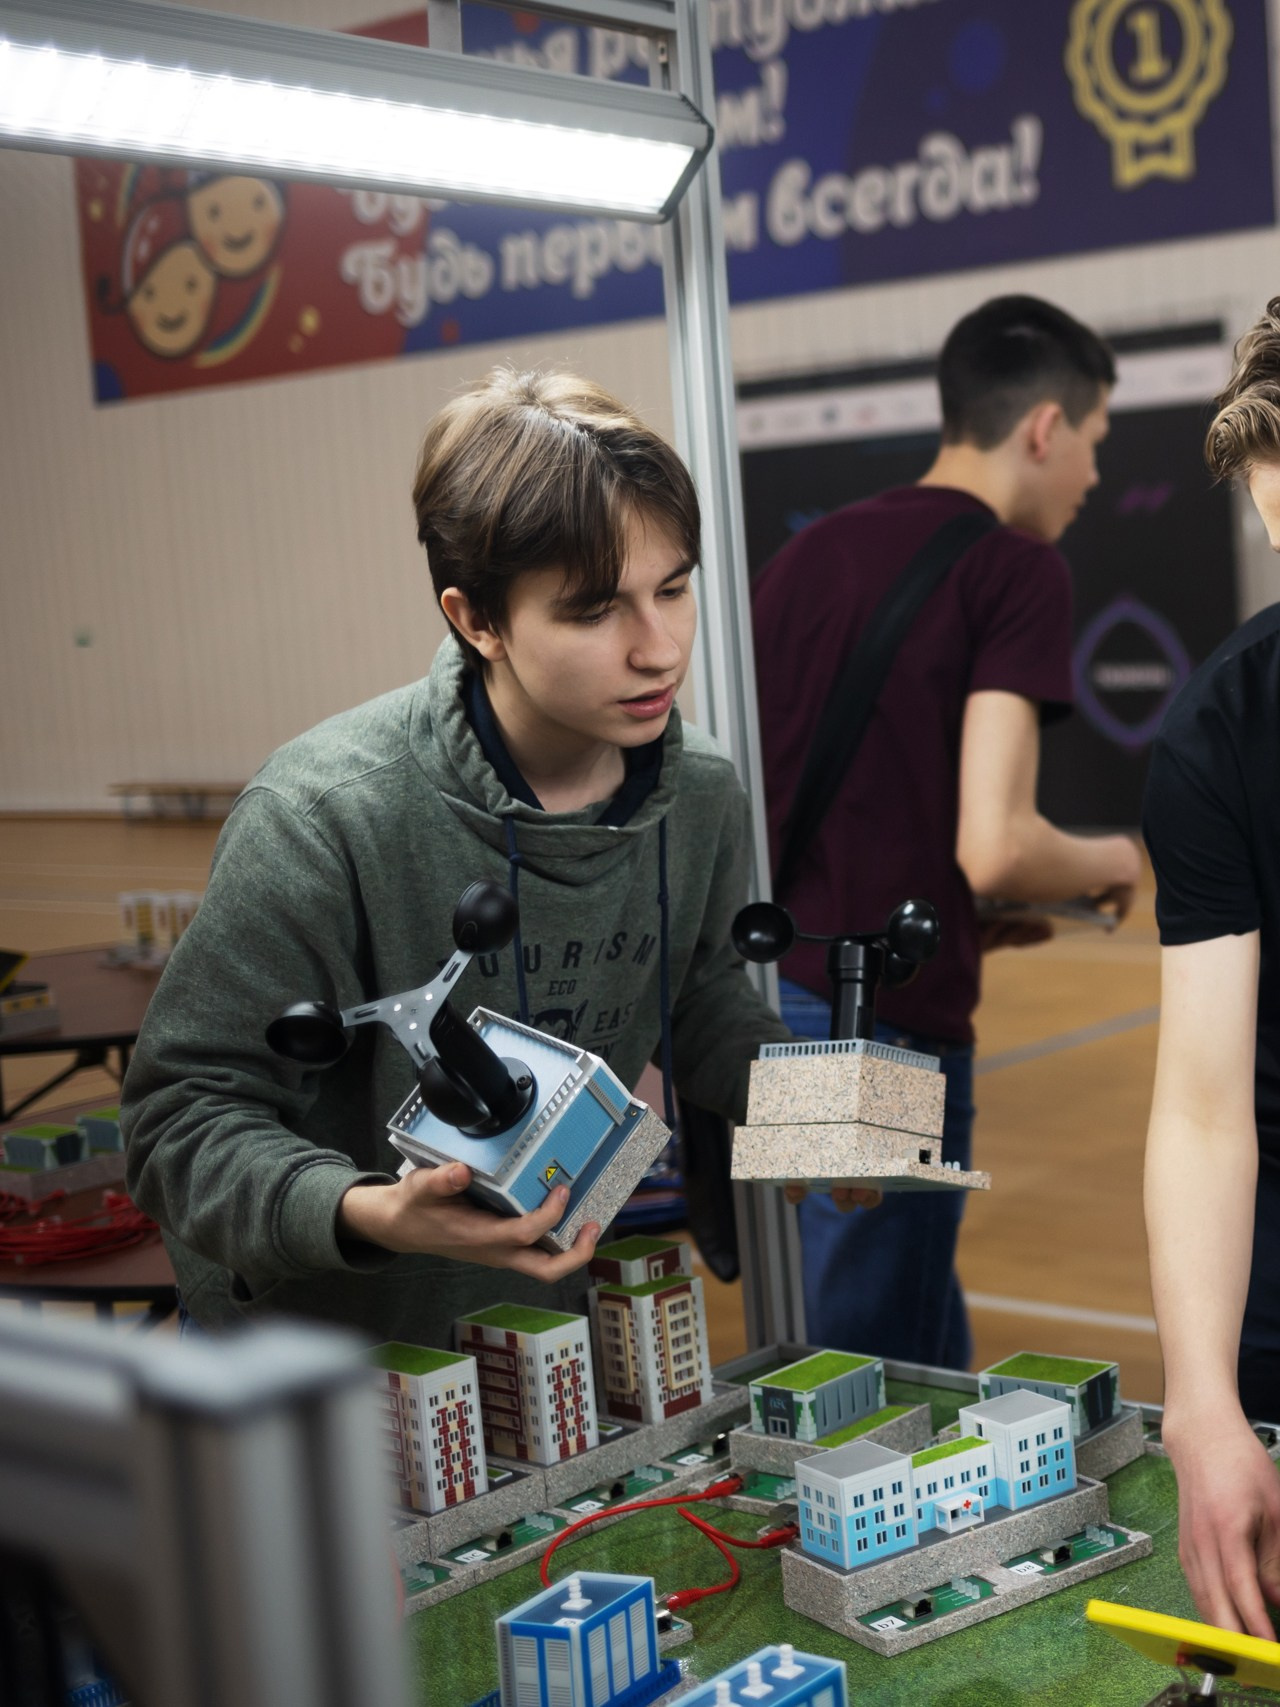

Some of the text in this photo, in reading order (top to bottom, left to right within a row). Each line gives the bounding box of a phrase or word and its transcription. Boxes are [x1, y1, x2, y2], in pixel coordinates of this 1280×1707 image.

[340, 226, 493, 328] Будь
[502, 193, 759, 300] первм
[766, 113, 1043, 247] всегда!
[436, 931, 657, 978] OURISM
[547, 979, 577, 997] ECO
